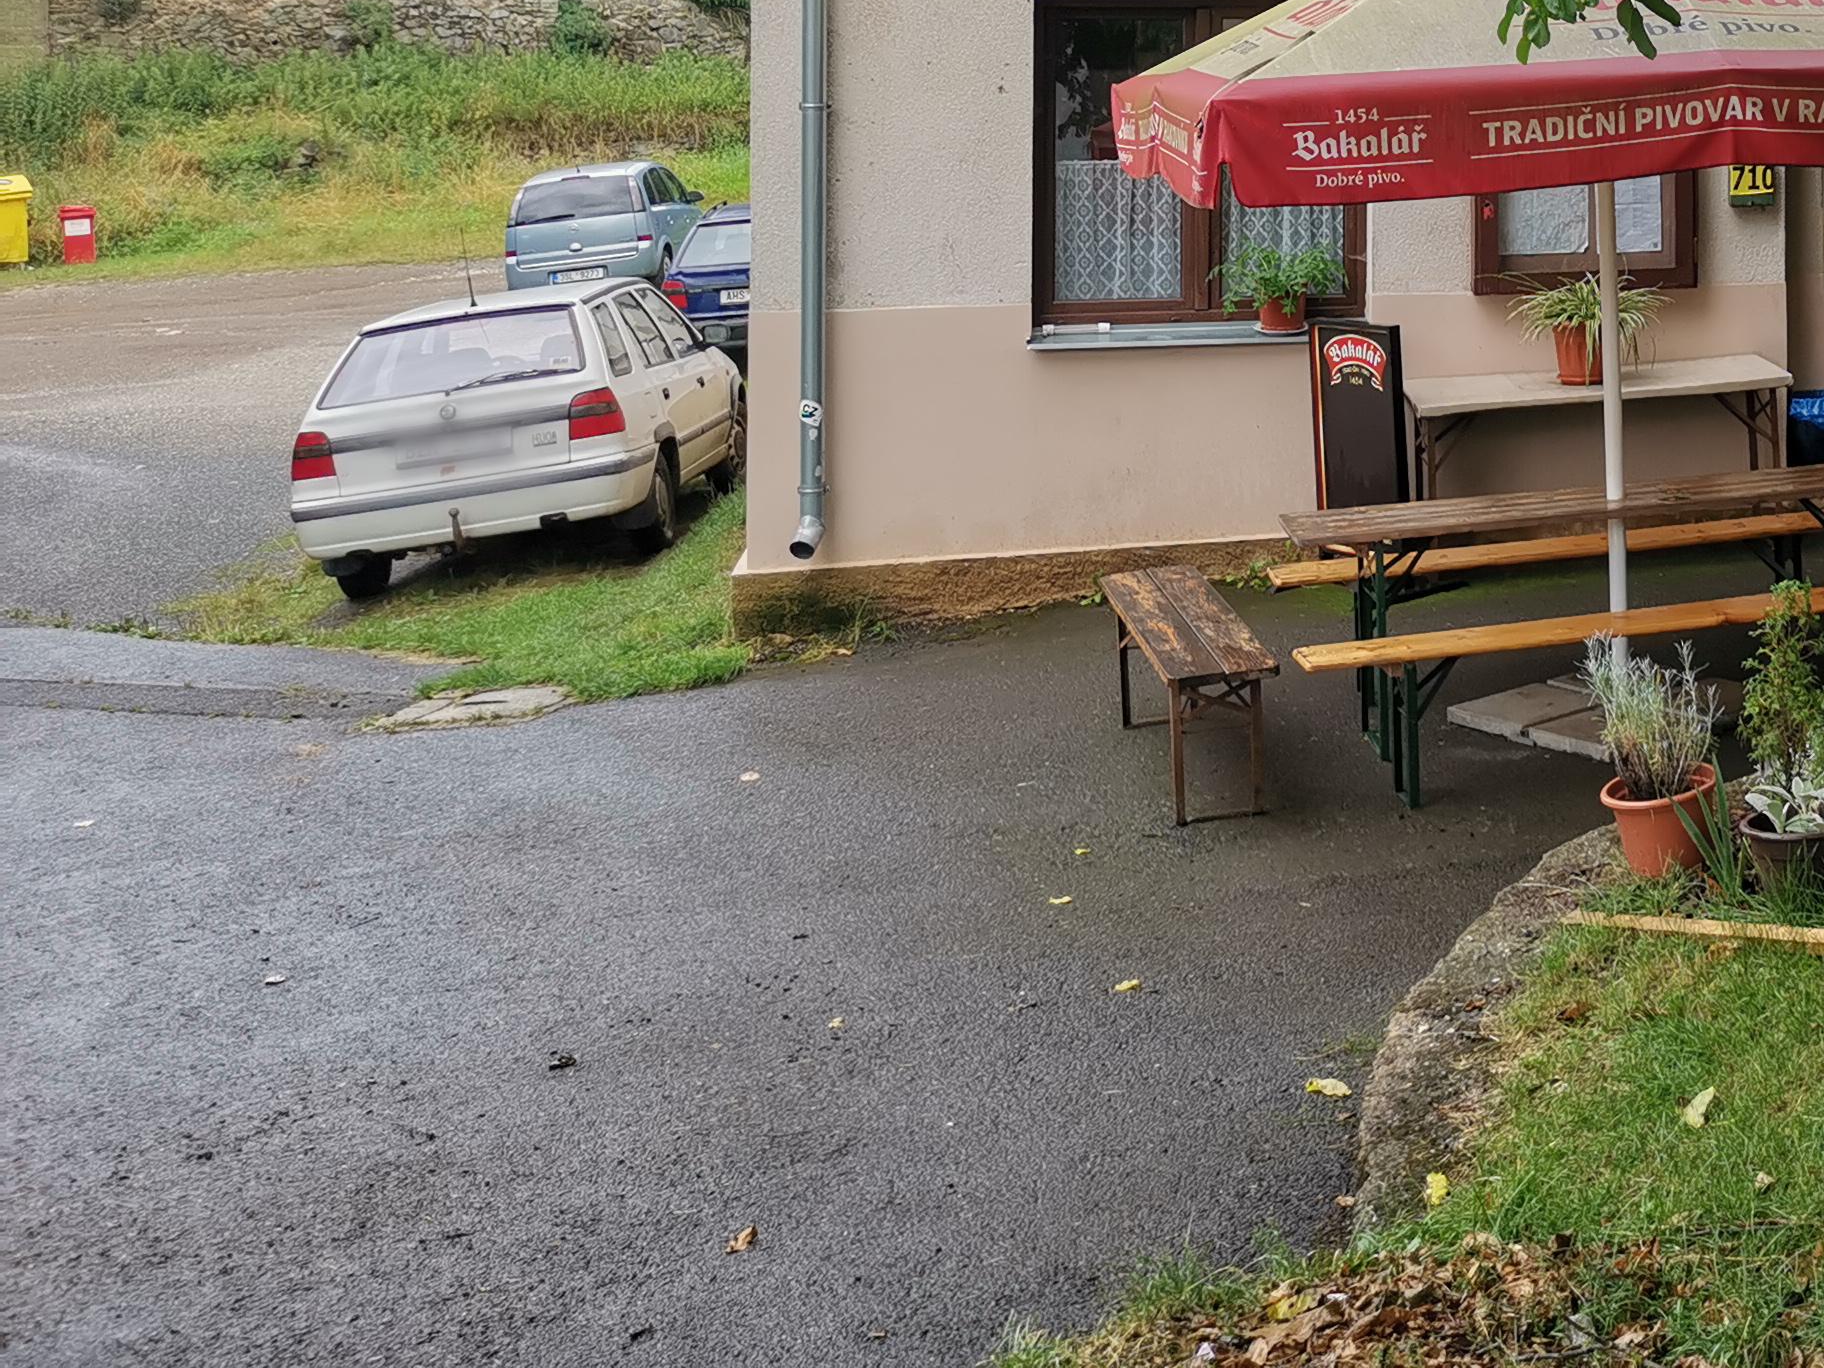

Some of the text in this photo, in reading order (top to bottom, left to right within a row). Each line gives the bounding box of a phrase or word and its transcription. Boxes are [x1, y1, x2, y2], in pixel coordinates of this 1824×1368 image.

[1589, 14, 1812, 41] Dbré pivo.
[1334, 106, 1380, 124] 1454
[1482, 102, 1628, 148] TRADIČNÍ
[1634, 94, 1764, 133] PIVOVAR
[1771, 98, 1791, 122] V
[1291, 123, 1428, 161] Bakalář
[1314, 169, 1406, 189] Dobré pivo.
[1732, 165, 1774, 190] 710
[1328, 339, 1382, 367] Bakalář
